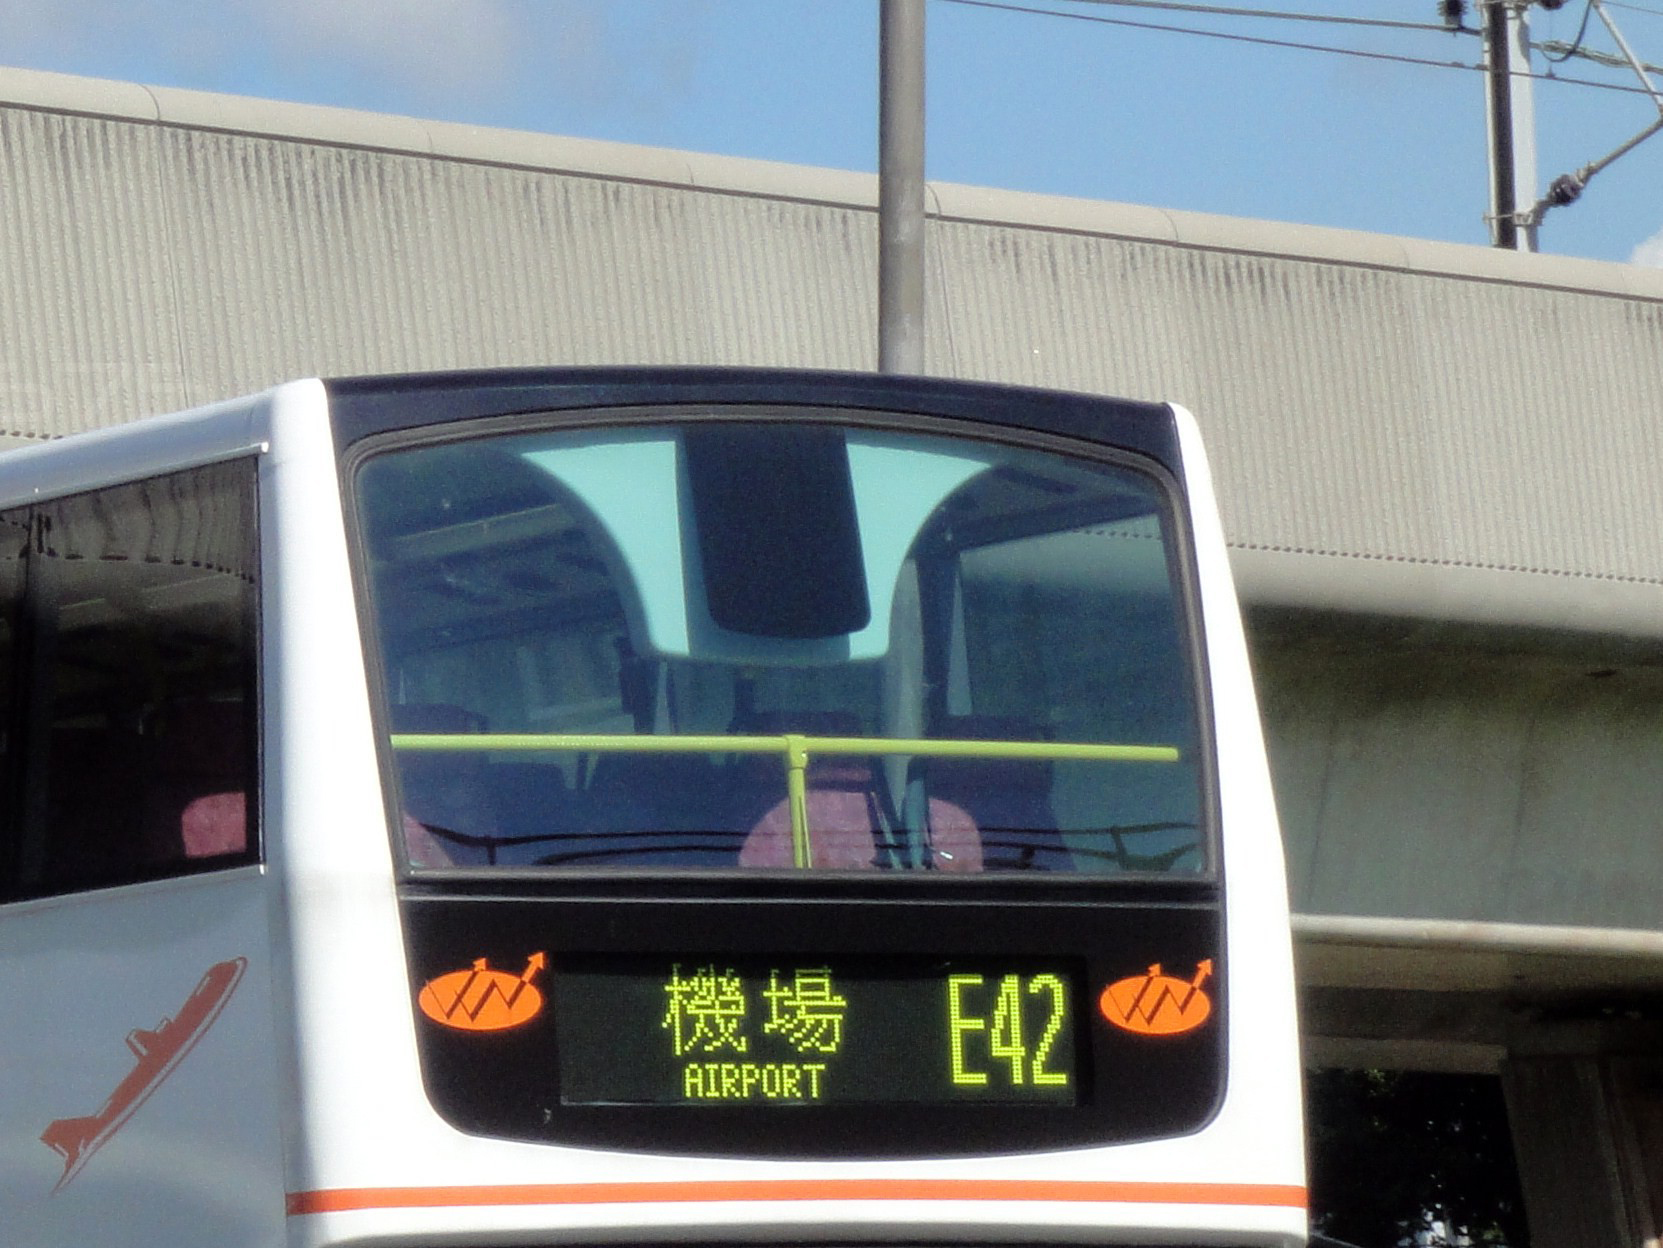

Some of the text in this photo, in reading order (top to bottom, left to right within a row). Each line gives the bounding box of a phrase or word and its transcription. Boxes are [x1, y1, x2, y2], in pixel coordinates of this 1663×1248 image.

[661, 963, 846, 1056] 機場
[948, 973, 1068, 1086] E42
[684, 1063, 827, 1099] AIRPORT
